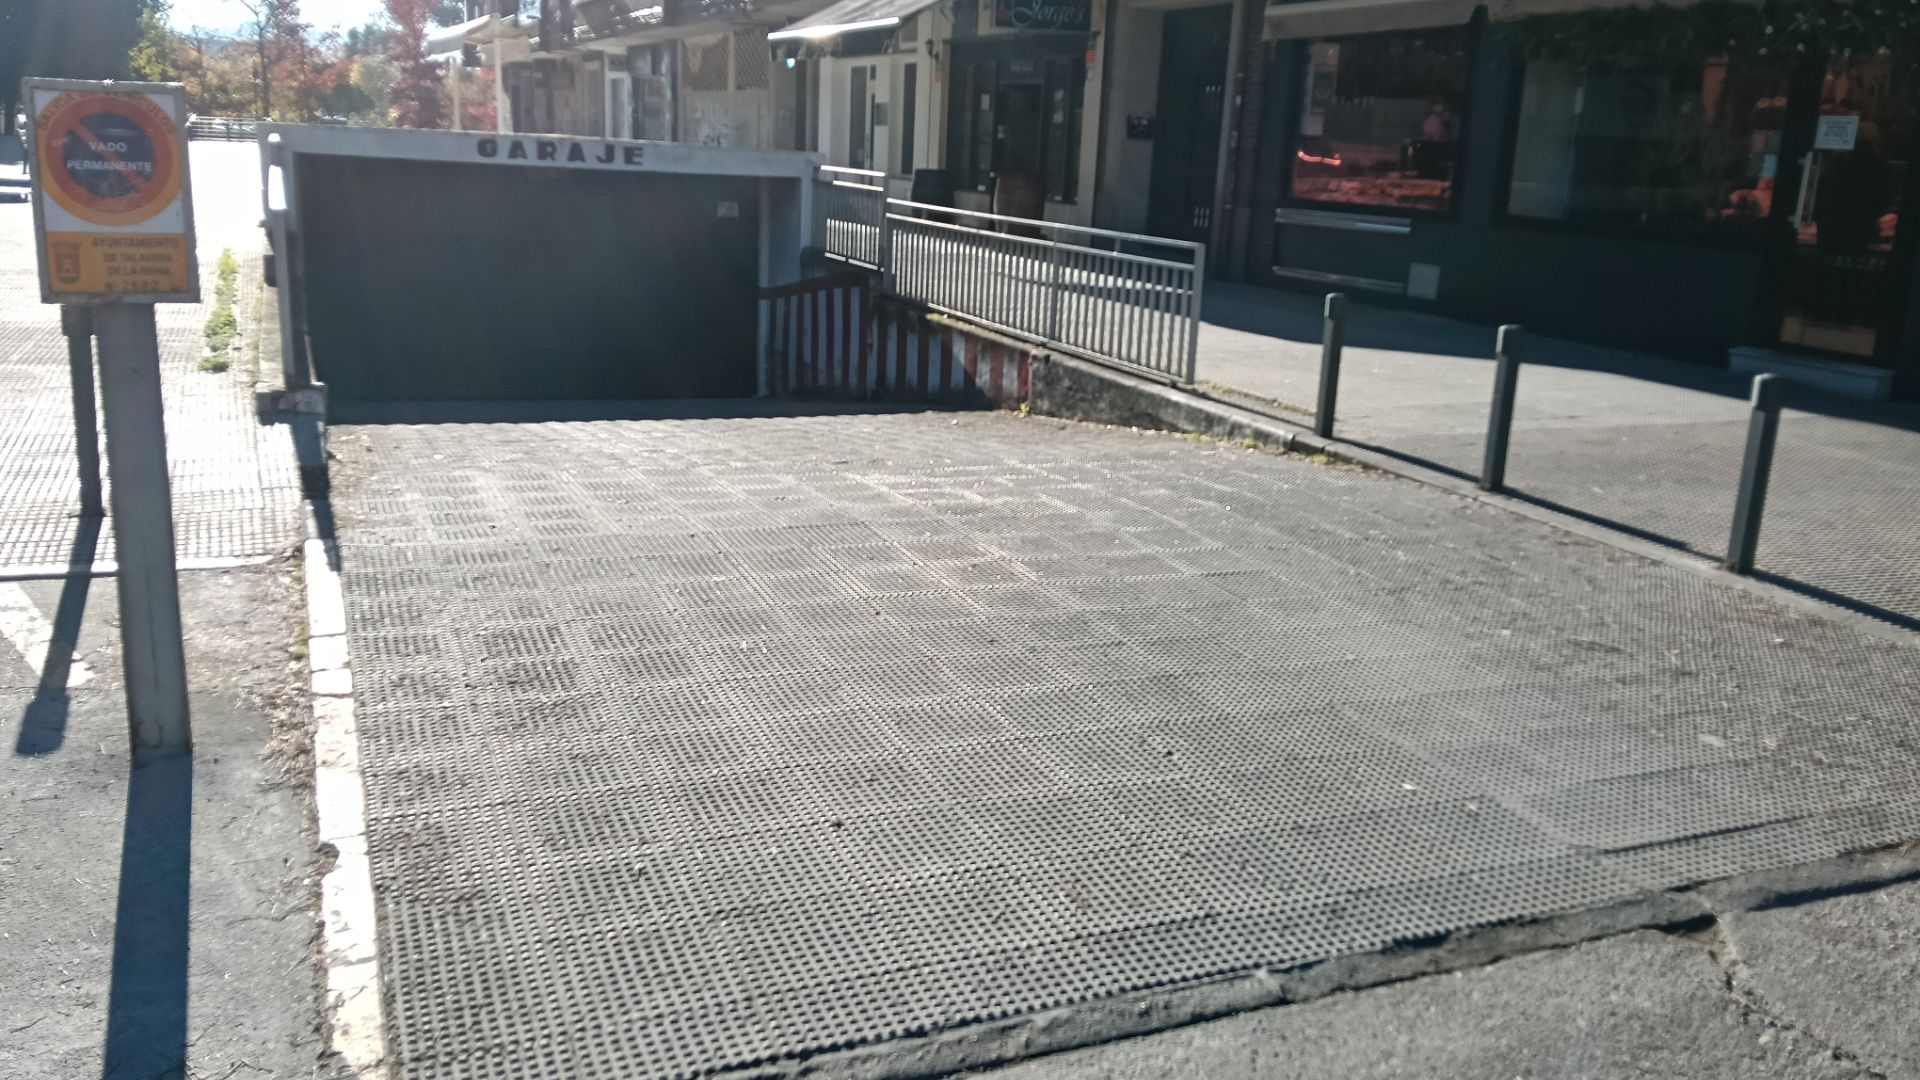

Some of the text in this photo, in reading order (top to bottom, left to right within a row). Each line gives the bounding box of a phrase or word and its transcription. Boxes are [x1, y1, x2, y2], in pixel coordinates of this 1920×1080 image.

[88, 141, 127, 152] VADO
[476, 137, 644, 166] GARAJE
[66, 159, 152, 172] PERMANENTE
[92, 237, 179, 249] AYUNTAMIENTO
[103, 252, 118, 263] DE
[106, 265, 121, 276] DE
